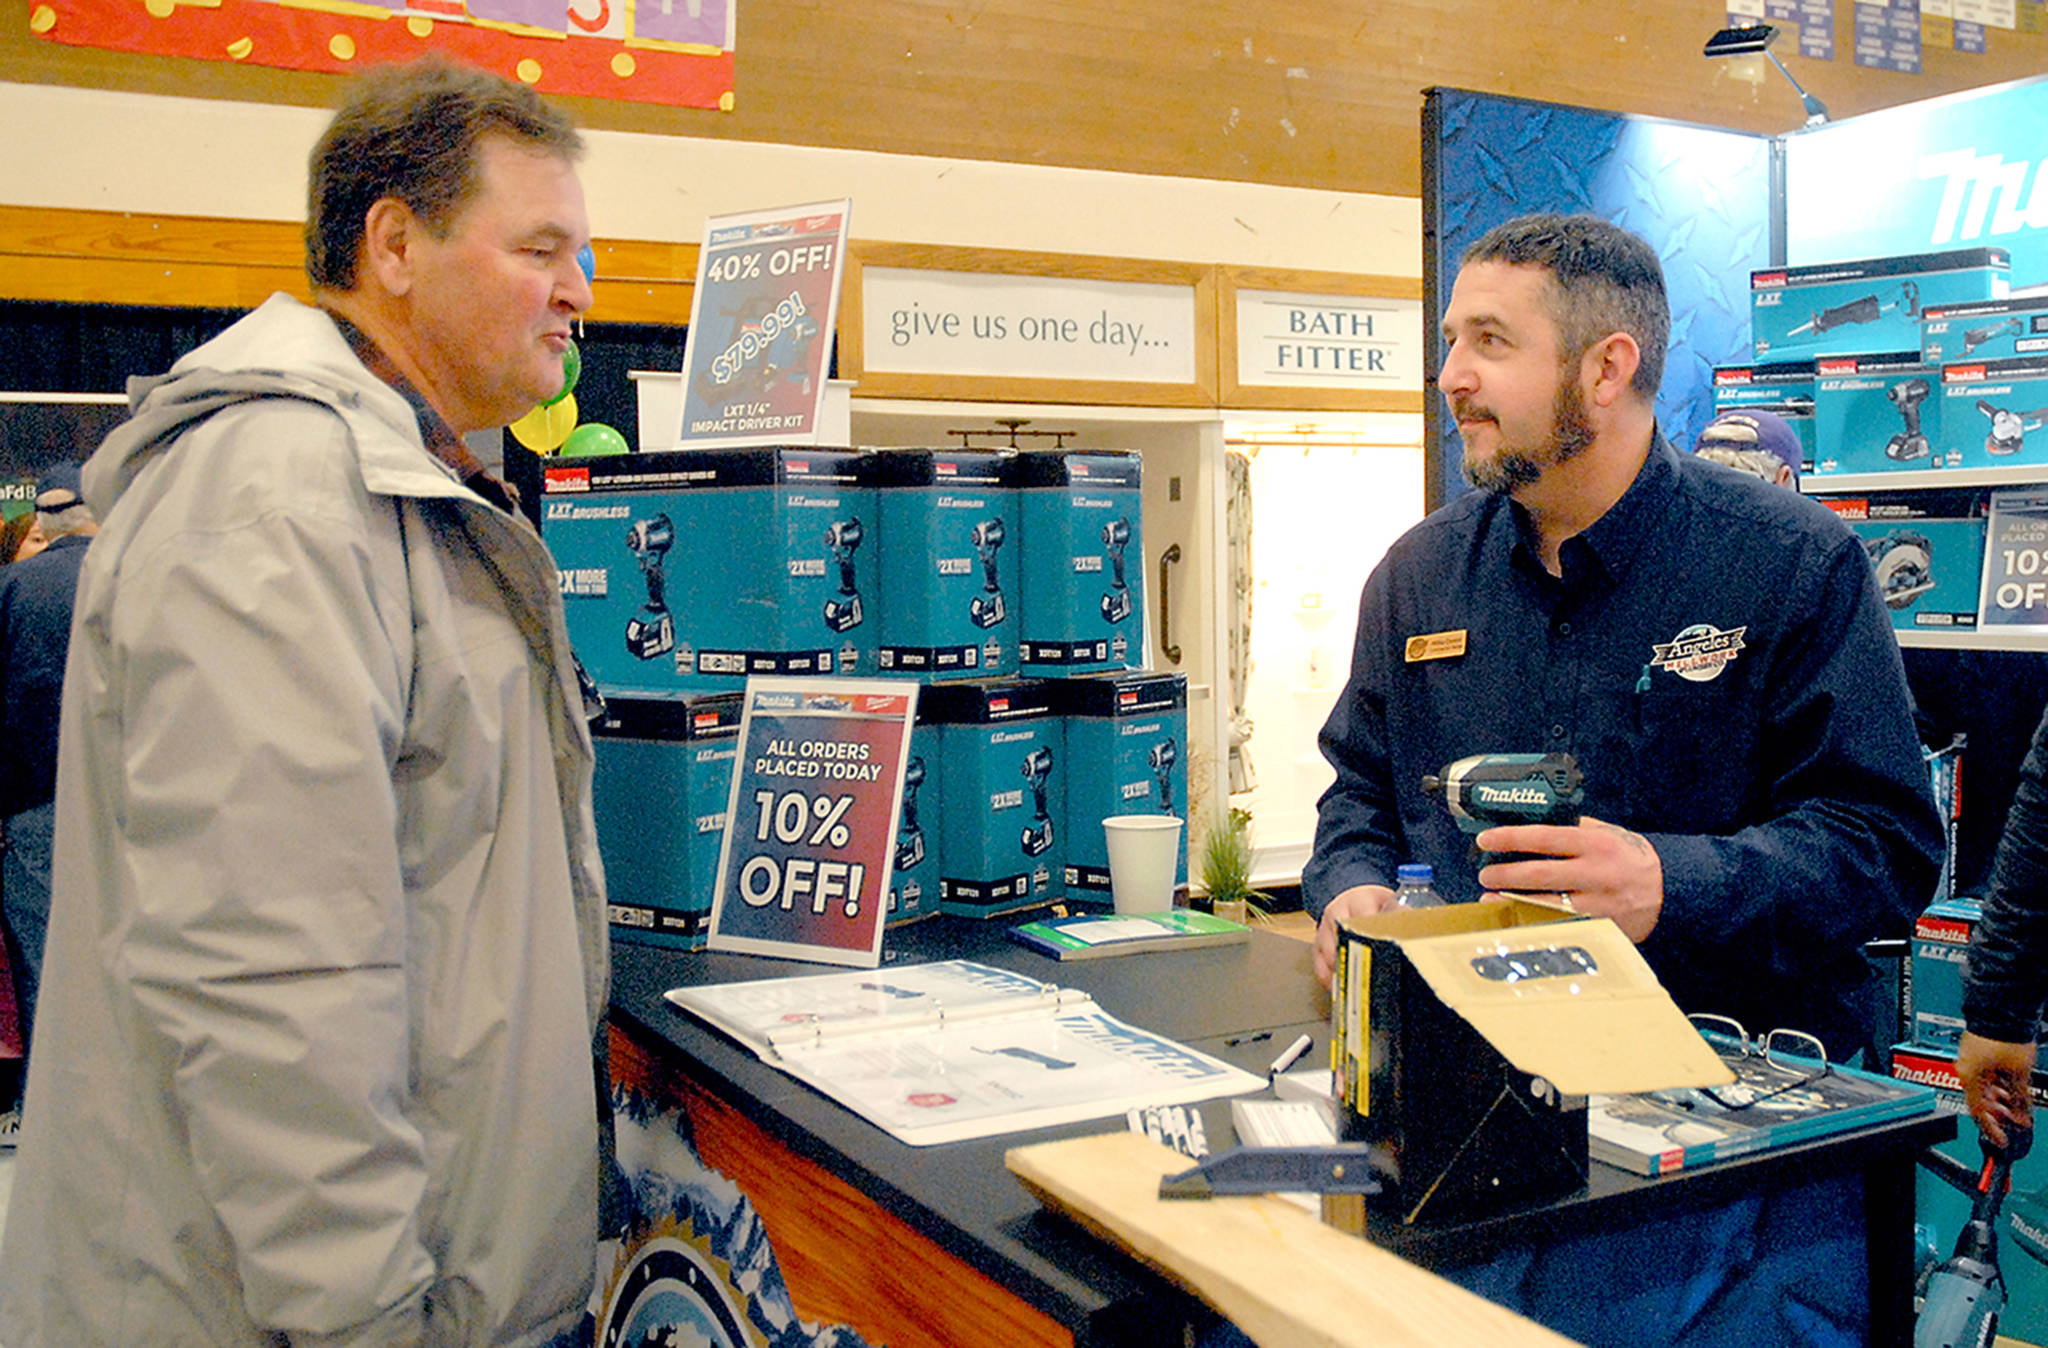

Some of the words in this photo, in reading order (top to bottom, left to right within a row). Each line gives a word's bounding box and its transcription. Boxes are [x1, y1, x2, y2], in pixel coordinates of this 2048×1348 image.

[707, 253, 762, 282] 40%
[769, 245, 832, 275] OFF!
[1755, 292, 1782, 306] LXT
[891, 301, 960, 347] give
[973, 314, 1007, 339] us
[1019, 317, 1078, 342] one
[1089, 310, 1169, 356] day...
[1290, 310, 1373, 336] BATH
[712, 291, 806, 384] $79.99!
[1278, 345, 1385, 371] FITTER
[724, 404, 746, 418] LXT
[691, 418, 737, 433] IMPACT
[738, 416, 781, 431] DRIVER
[783, 414, 804, 428] KIT
[547, 503, 573, 519] LXT
[572, 506, 631, 519] BRUSHLESS
[2003, 549, 2048, 576] 10
[1667, 635, 1730, 659] Angeles
[1666, 649, 1738, 670] MILLWORK
[766, 740, 796, 756] ALL
[800, 741, 870, 759] ORDERS
[755, 759, 819, 776] PLACED
[823, 762, 882, 781] TODAY
[1478, 786, 1548, 805] Makita
[756, 791, 853, 848] 10%
[739, 856, 865, 918] OFF!
[1916, 925, 1968, 943] Makita
[1893, 1062, 1964, 1091] Makita
